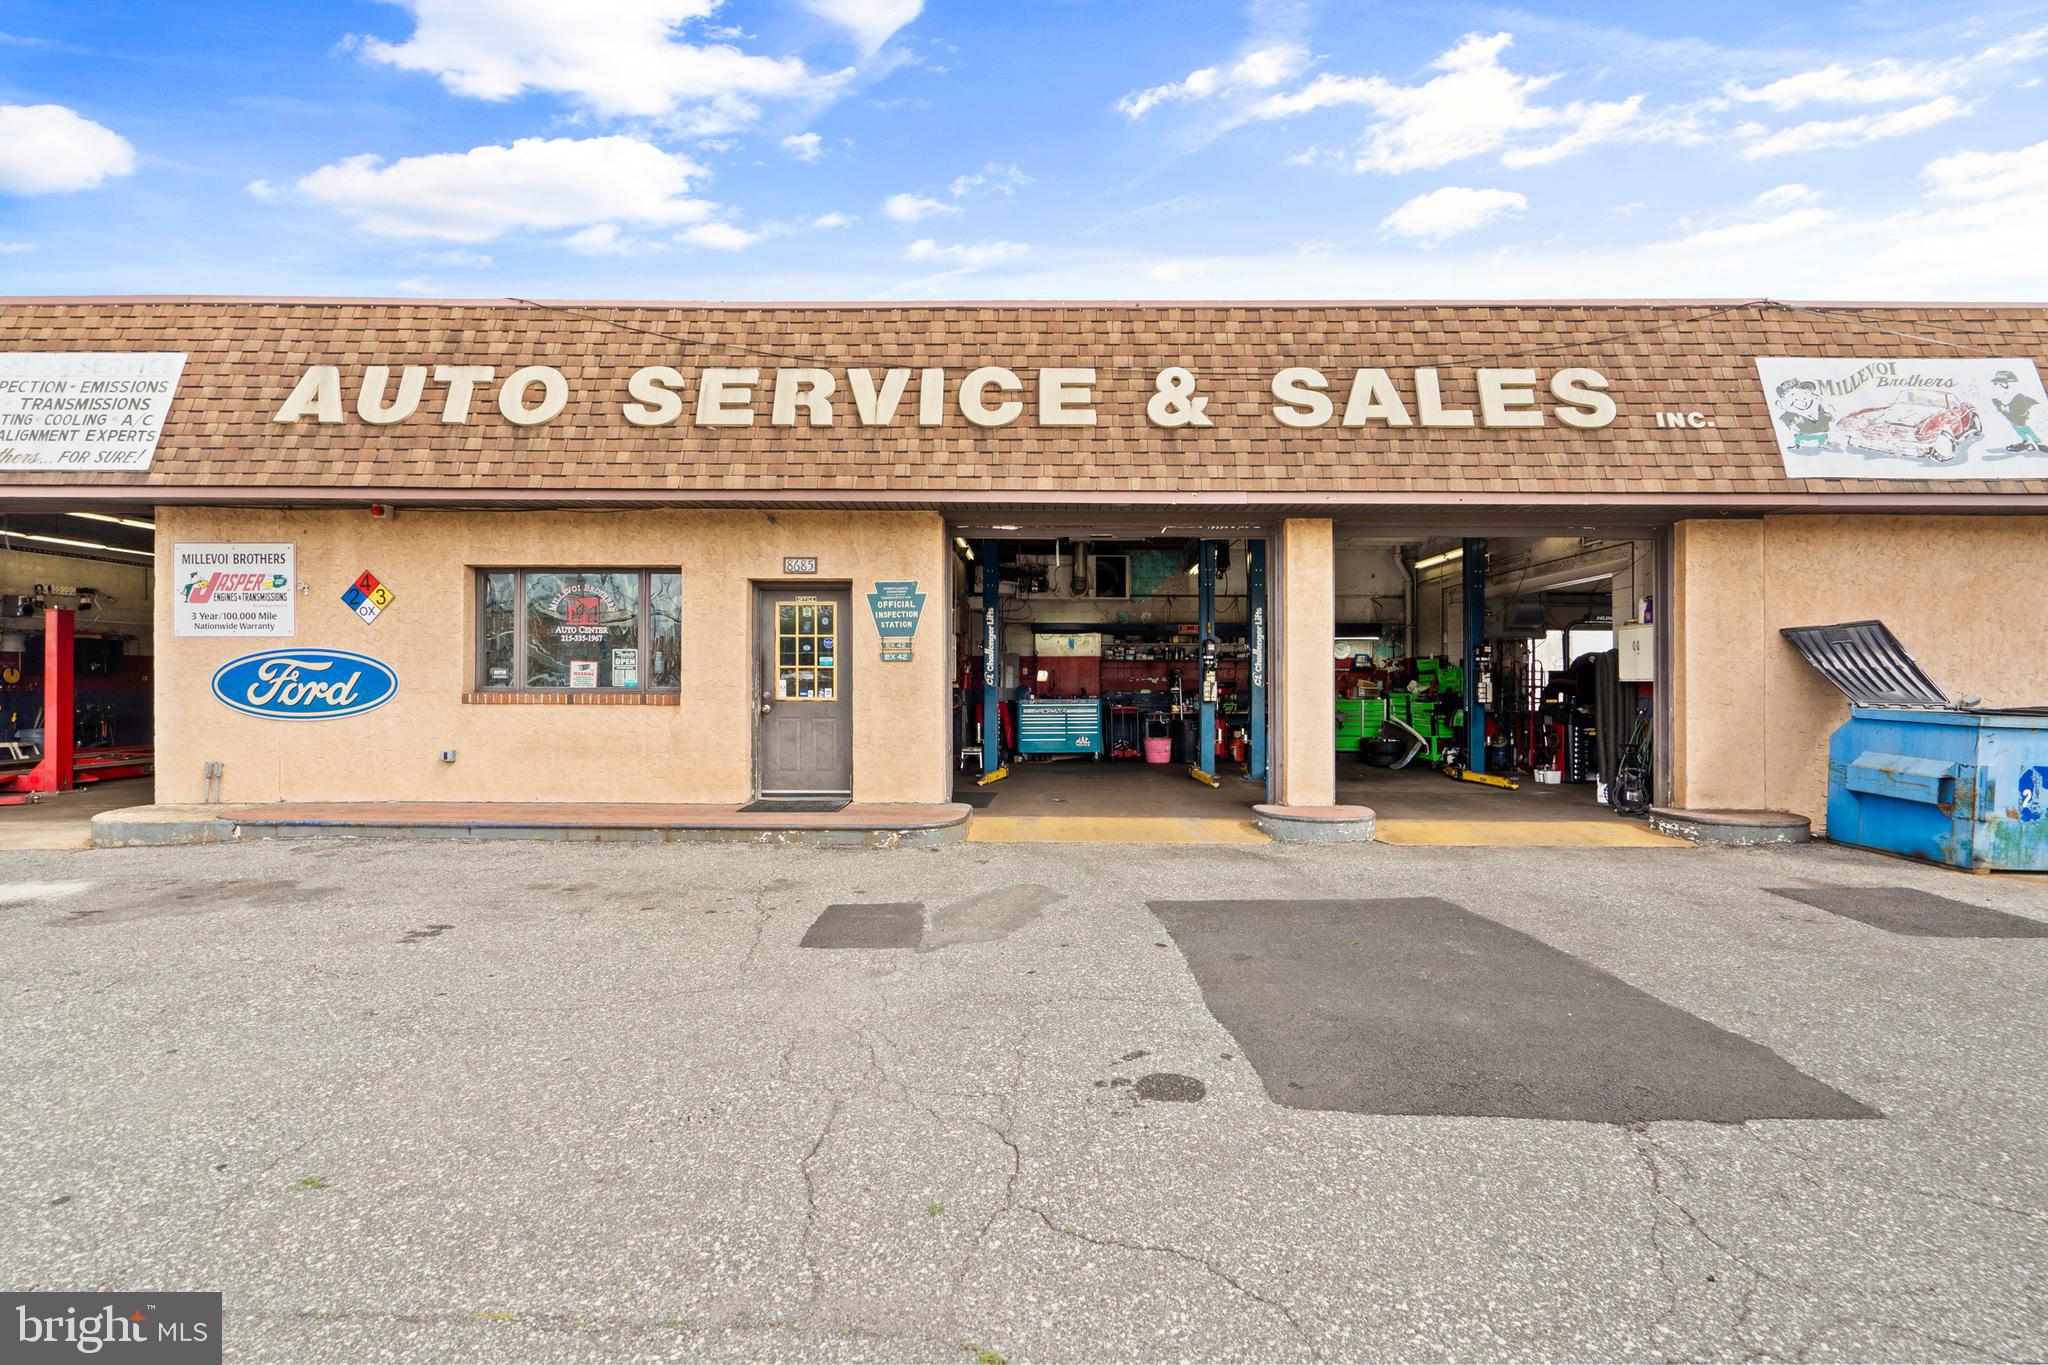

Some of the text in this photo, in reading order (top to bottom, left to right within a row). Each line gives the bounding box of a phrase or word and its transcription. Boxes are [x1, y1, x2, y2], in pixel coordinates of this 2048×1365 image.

[1816, 361, 1897, 396] MILLEVOI
[1876, 373, 1958, 389] Brothers
[80, 381, 170, 393] EMISSIONS
[21, 398, 152, 410] TRANSMISSIONS
[272, 365, 1715, 429] AUTO SERVICE & SALES INC.
[44, 414, 107, 426] COOLING
[121, 413, 154, 428] A/C
[85, 430, 156, 442] EXPERTS
[57, 451, 91, 464] FOR
[93, 449, 147, 464] SURE!
[181, 553, 286, 565] MILLEVOI BROTHERS
[786, 558, 814, 572] 8685
[189, 572, 266, 604] JASPER
[360, 574, 372, 591] 4
[213, 592, 238, 602] ENGINES
[242, 592, 288, 602] TRANSMISSIONS
[349, 588, 360, 605] 2
[375, 588, 387, 605] 3
[192, 612, 197, 620] 3
[258, 612, 278, 620] Mile
[359, 606, 376, 617] OX
[875, 610, 919, 618] INSPECTION
[986, 607, 994, 625] Lifts
[1254, 607, 1262, 625] Lifts
[194, 622, 275, 632] Nationwide Warranty
[555, 625, 608, 634] AUTO CENTER
[561, 634, 603, 642] 215-335-1967
[984, 625, 997, 672] Challenger
[1252, 624, 1265, 671] Challenger
[247, 658, 362, 706] Ford
